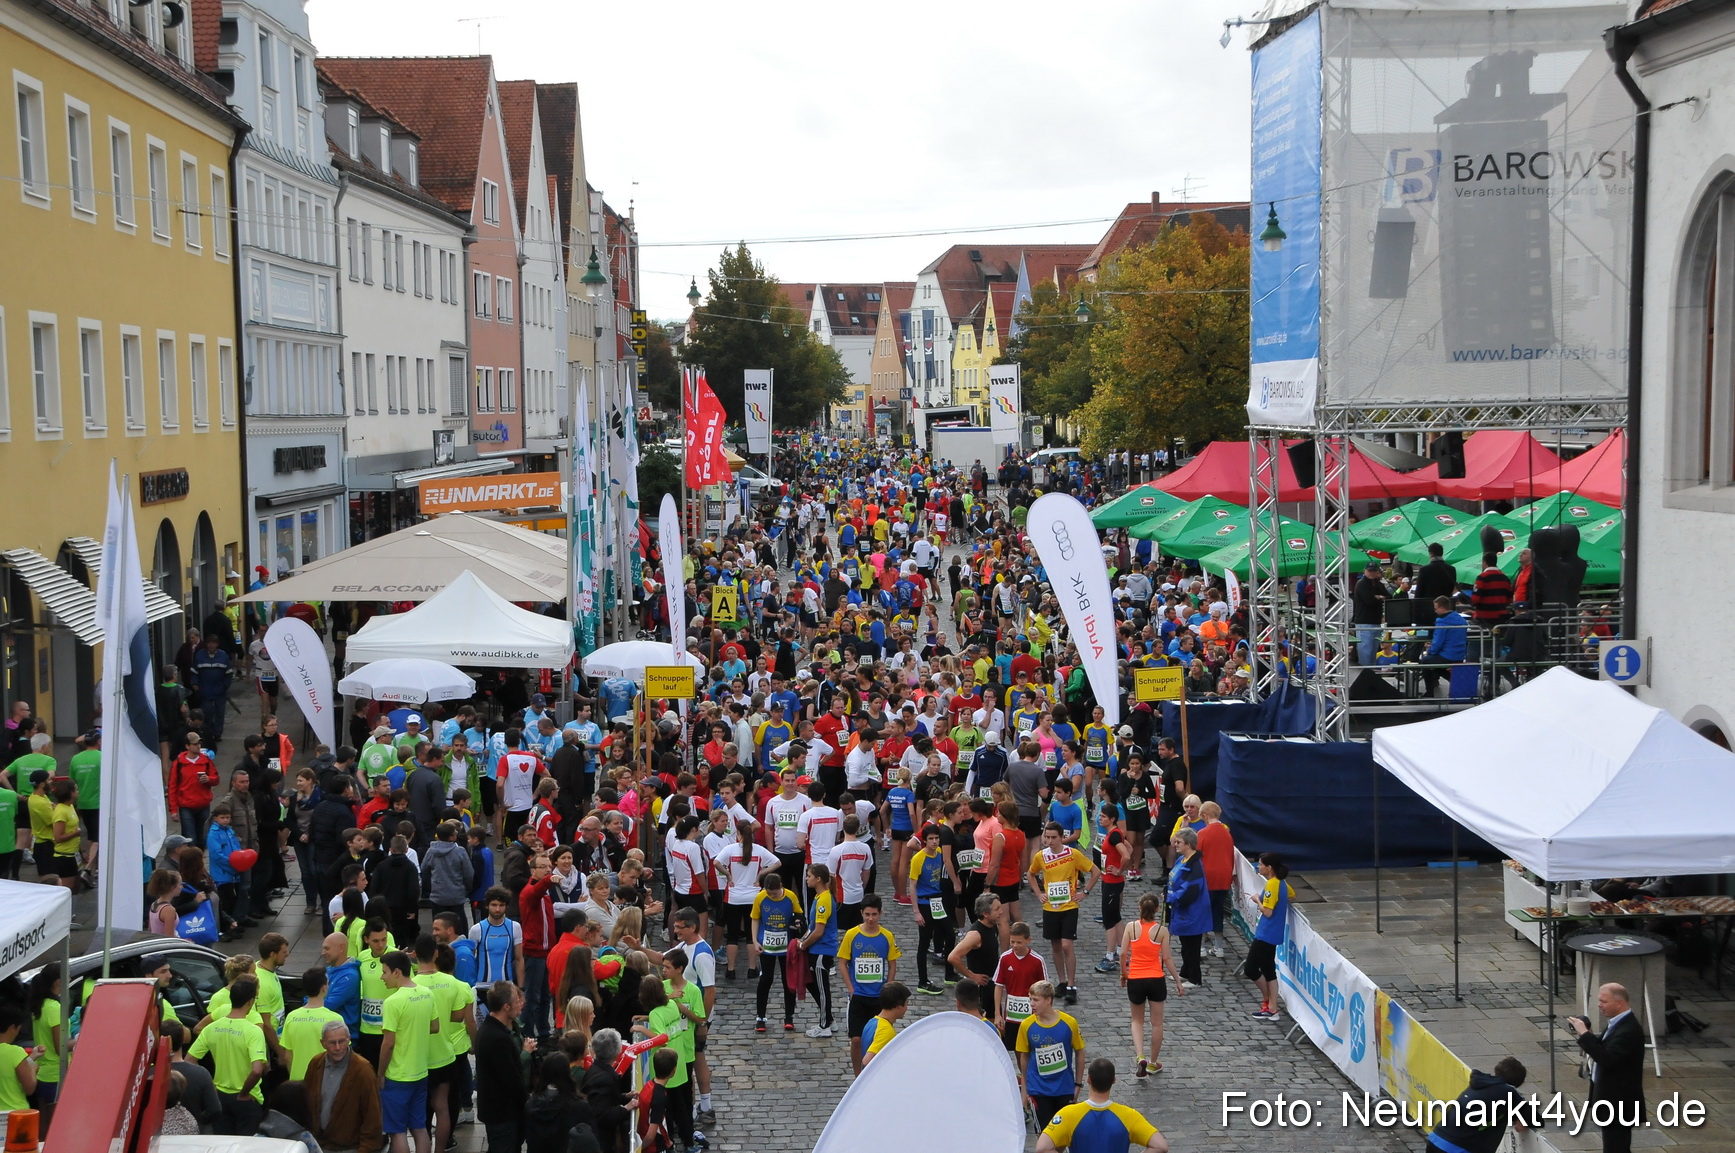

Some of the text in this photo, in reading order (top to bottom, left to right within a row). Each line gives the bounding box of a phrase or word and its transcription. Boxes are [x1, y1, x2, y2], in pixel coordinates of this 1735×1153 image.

[1454, 150, 1635, 183] BAROWSK
[632, 311, 647, 390] HOTEL
[1453, 344, 1631, 364] www.barowski-ag
[332, 584, 447, 593] BELACCANT
[715, 587, 735, 595] Block
[717, 596, 731, 614] A
[450, 650, 539, 659] www.audibkk.de
[649, 675, 691, 687] Schnupper-
[1138, 677, 1180, 686] Schnupper-
[663, 683, 677, 691] lauf
[1152, 685, 1166, 693] lauf
[382, 692, 401, 700] Audi
[779, 813, 796, 822] 5191
[1050, 887, 1068, 896] 5155
[0, 919, 46, 968] aufsport
[765, 936, 786, 946] 5207
[857, 963, 881, 974] 5518
[1008, 1001, 1030, 1013] 5523
[1038, 1050, 1064, 1065] 5519
